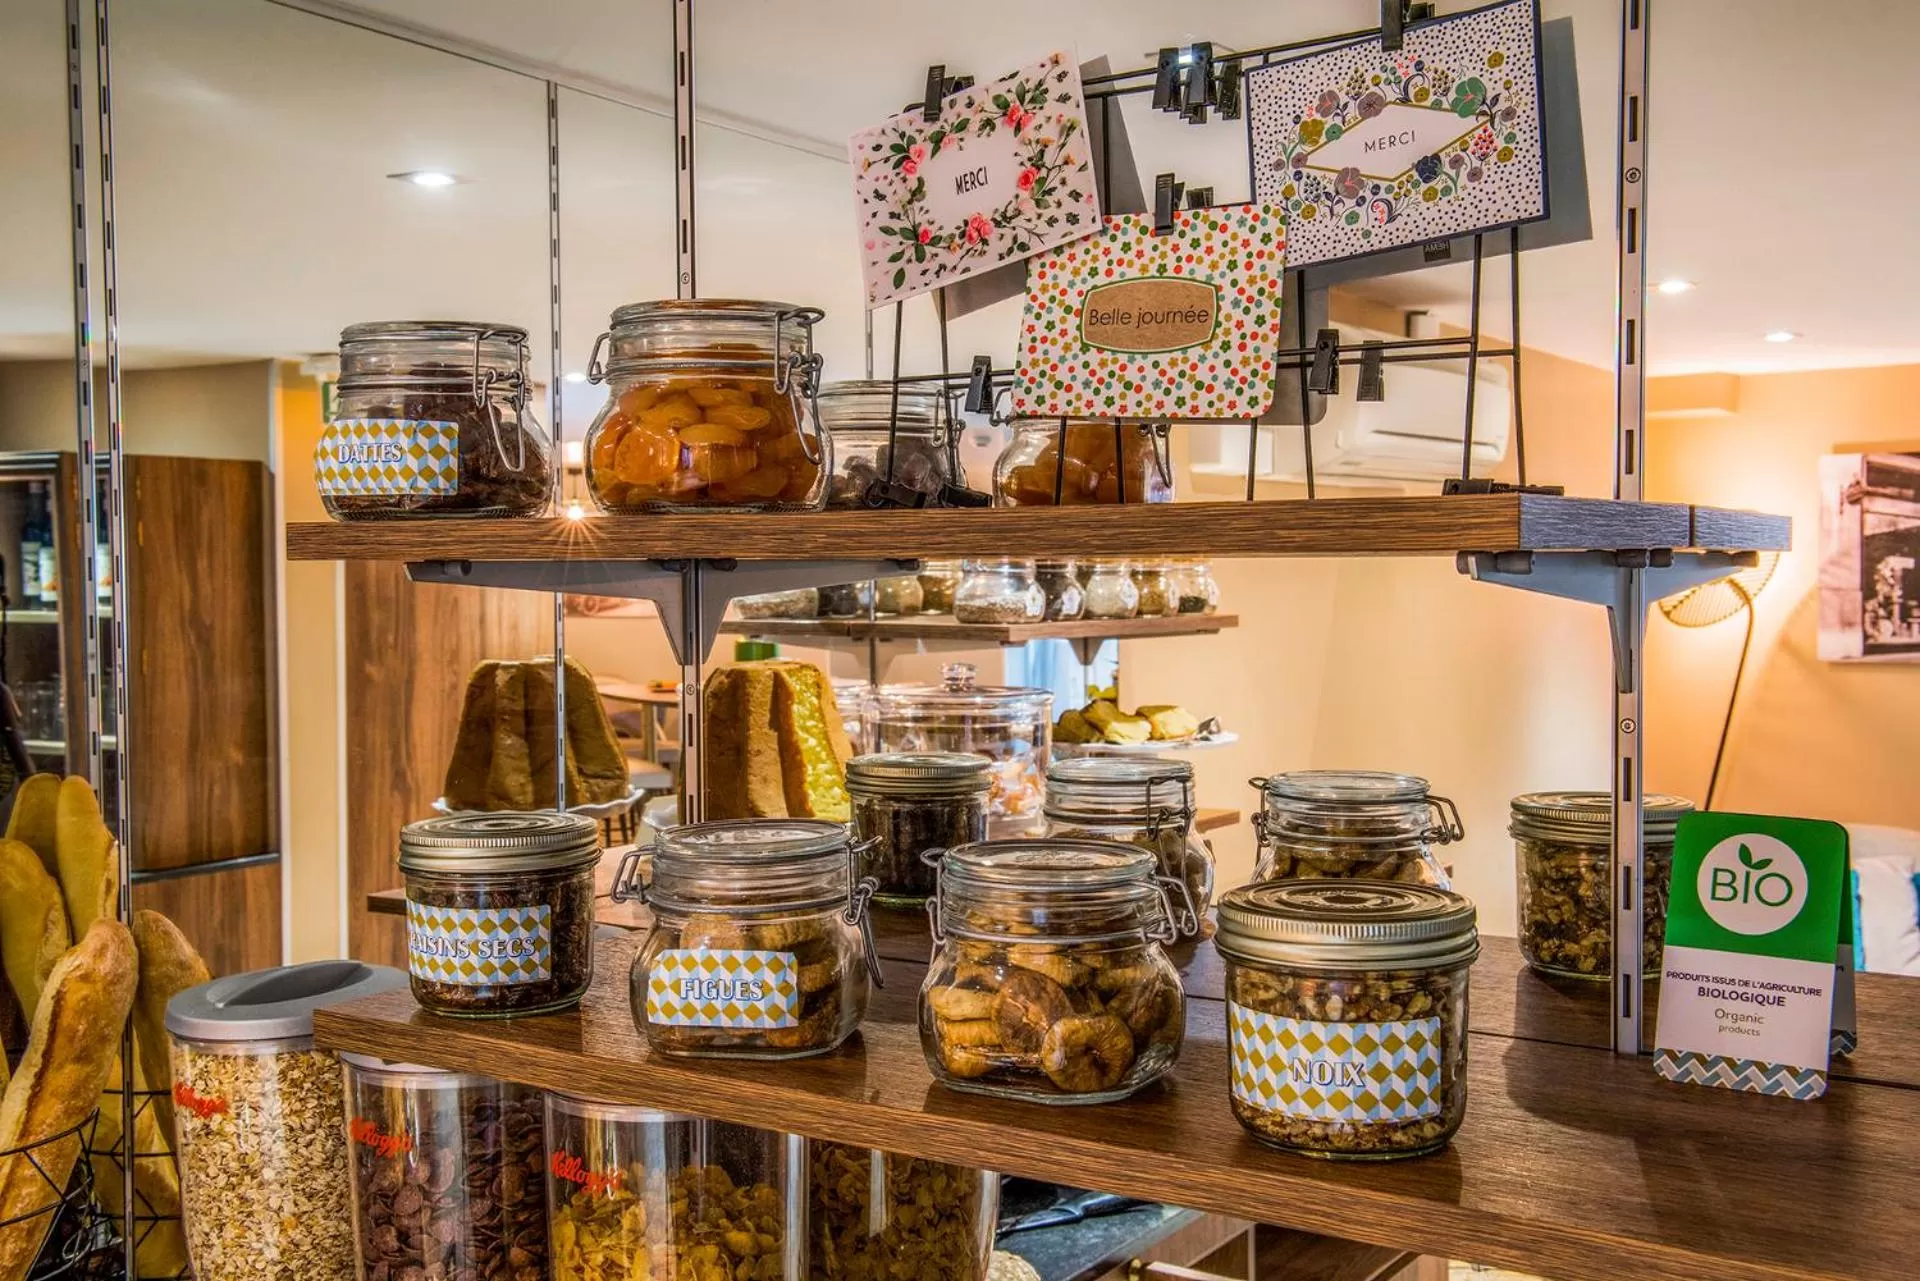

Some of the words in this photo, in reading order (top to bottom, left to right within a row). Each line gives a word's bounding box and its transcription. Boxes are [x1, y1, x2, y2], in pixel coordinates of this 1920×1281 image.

[1364, 129, 1415, 153] MERCI
[954, 165, 989, 195] MERCI
[1088, 307, 1133, 326] Belle
[1135, 304, 1210, 329] journée
[337, 441, 404, 464] DATTES
[1710, 867, 1794, 907] BIO
[477, 935, 537, 960] SECS
[679, 977, 765, 1002] FIGUES
[1665, 970, 1711, 984] PRODUITS
[1712, 975, 1737, 987] ISSUS
[1738, 978, 1750, 988] DE
[1751, 980, 1823, 997] L'AGRICULTURE
[1697, 985, 1787, 1008] BIOLOGIQUE
[1714, 1006, 1765, 1025] Organic
[1718, 1023, 1761, 1037] products
[1292, 1057, 1366, 1089] NOIX
